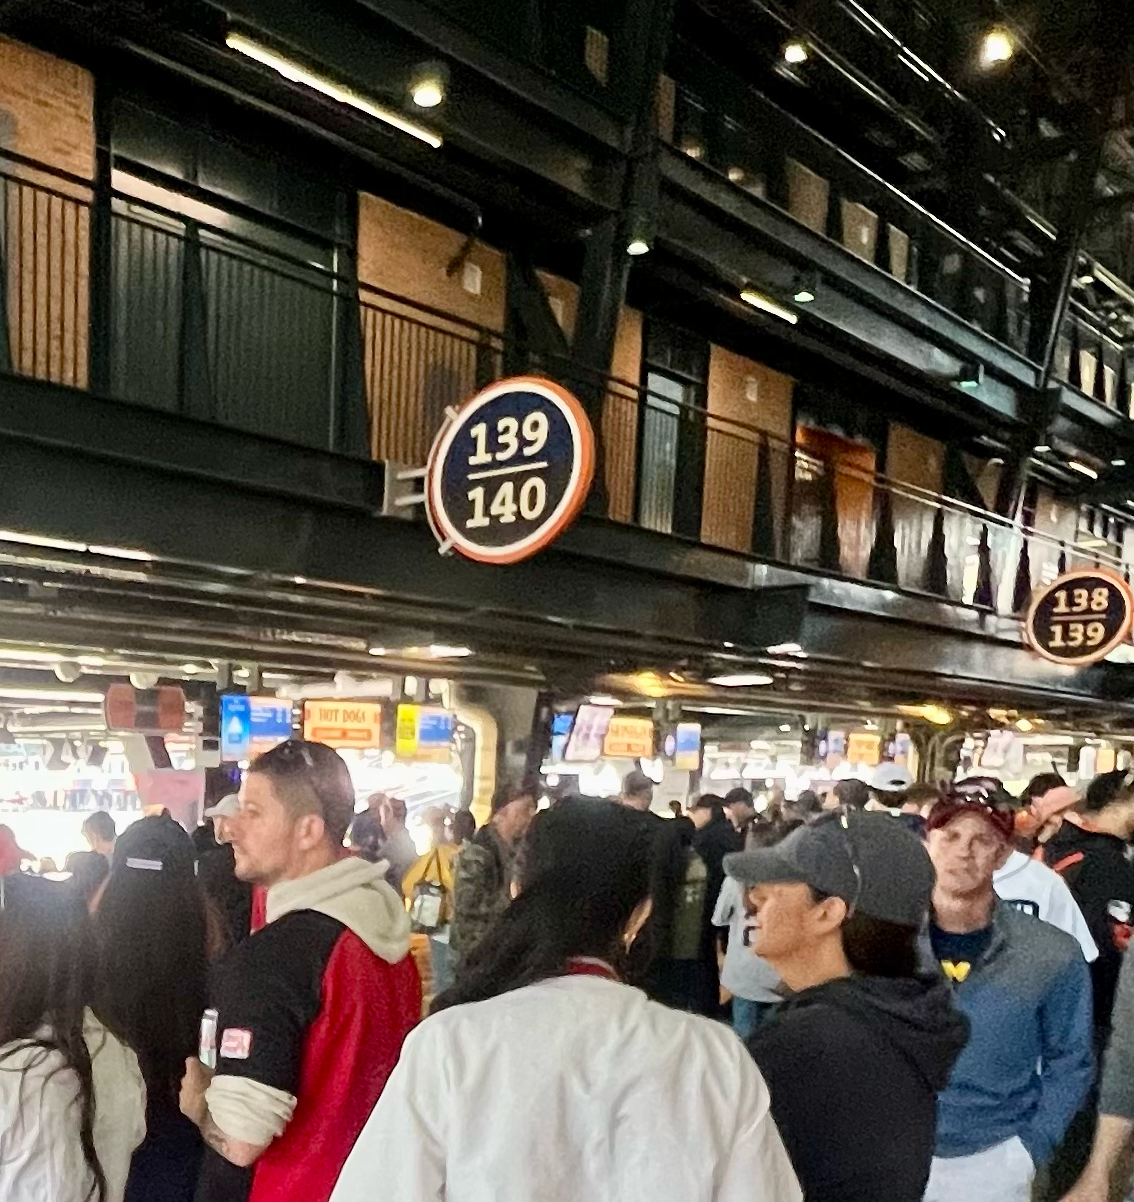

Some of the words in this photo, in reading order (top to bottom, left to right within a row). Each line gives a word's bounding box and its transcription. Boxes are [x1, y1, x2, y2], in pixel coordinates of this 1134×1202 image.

[468, 411, 549, 466] 139
[466, 476, 547, 529] 140
[1052, 587, 1109, 614] 138
[1048, 622, 1106, 648] 139
[319, 707, 340, 723] HOT
[342, 708, 366, 724] DOGS
